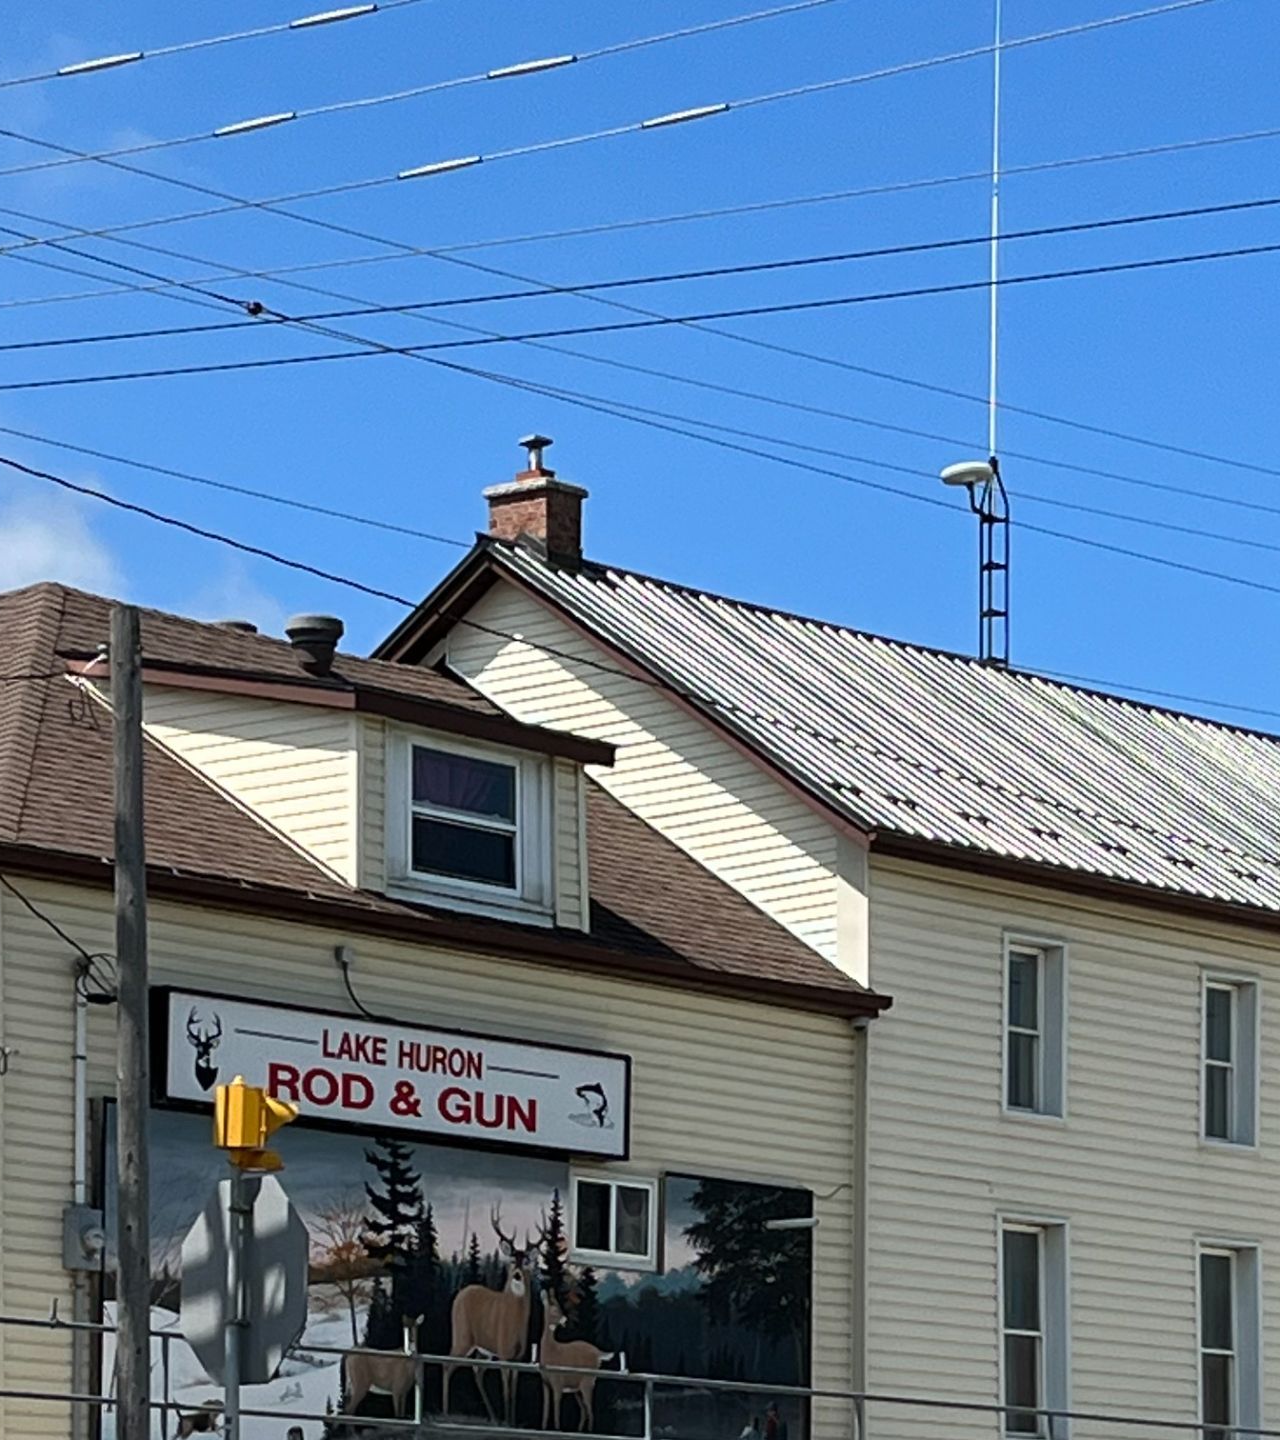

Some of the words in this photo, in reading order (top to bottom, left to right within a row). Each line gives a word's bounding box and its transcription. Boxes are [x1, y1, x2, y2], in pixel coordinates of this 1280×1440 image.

[322, 1028, 388, 1067] LAKE
[398, 1040, 483, 1080] HURON
[268, 1062, 374, 1110] ROD
[389, 1080, 422, 1117] &
[438, 1086, 537, 1132] GUN
